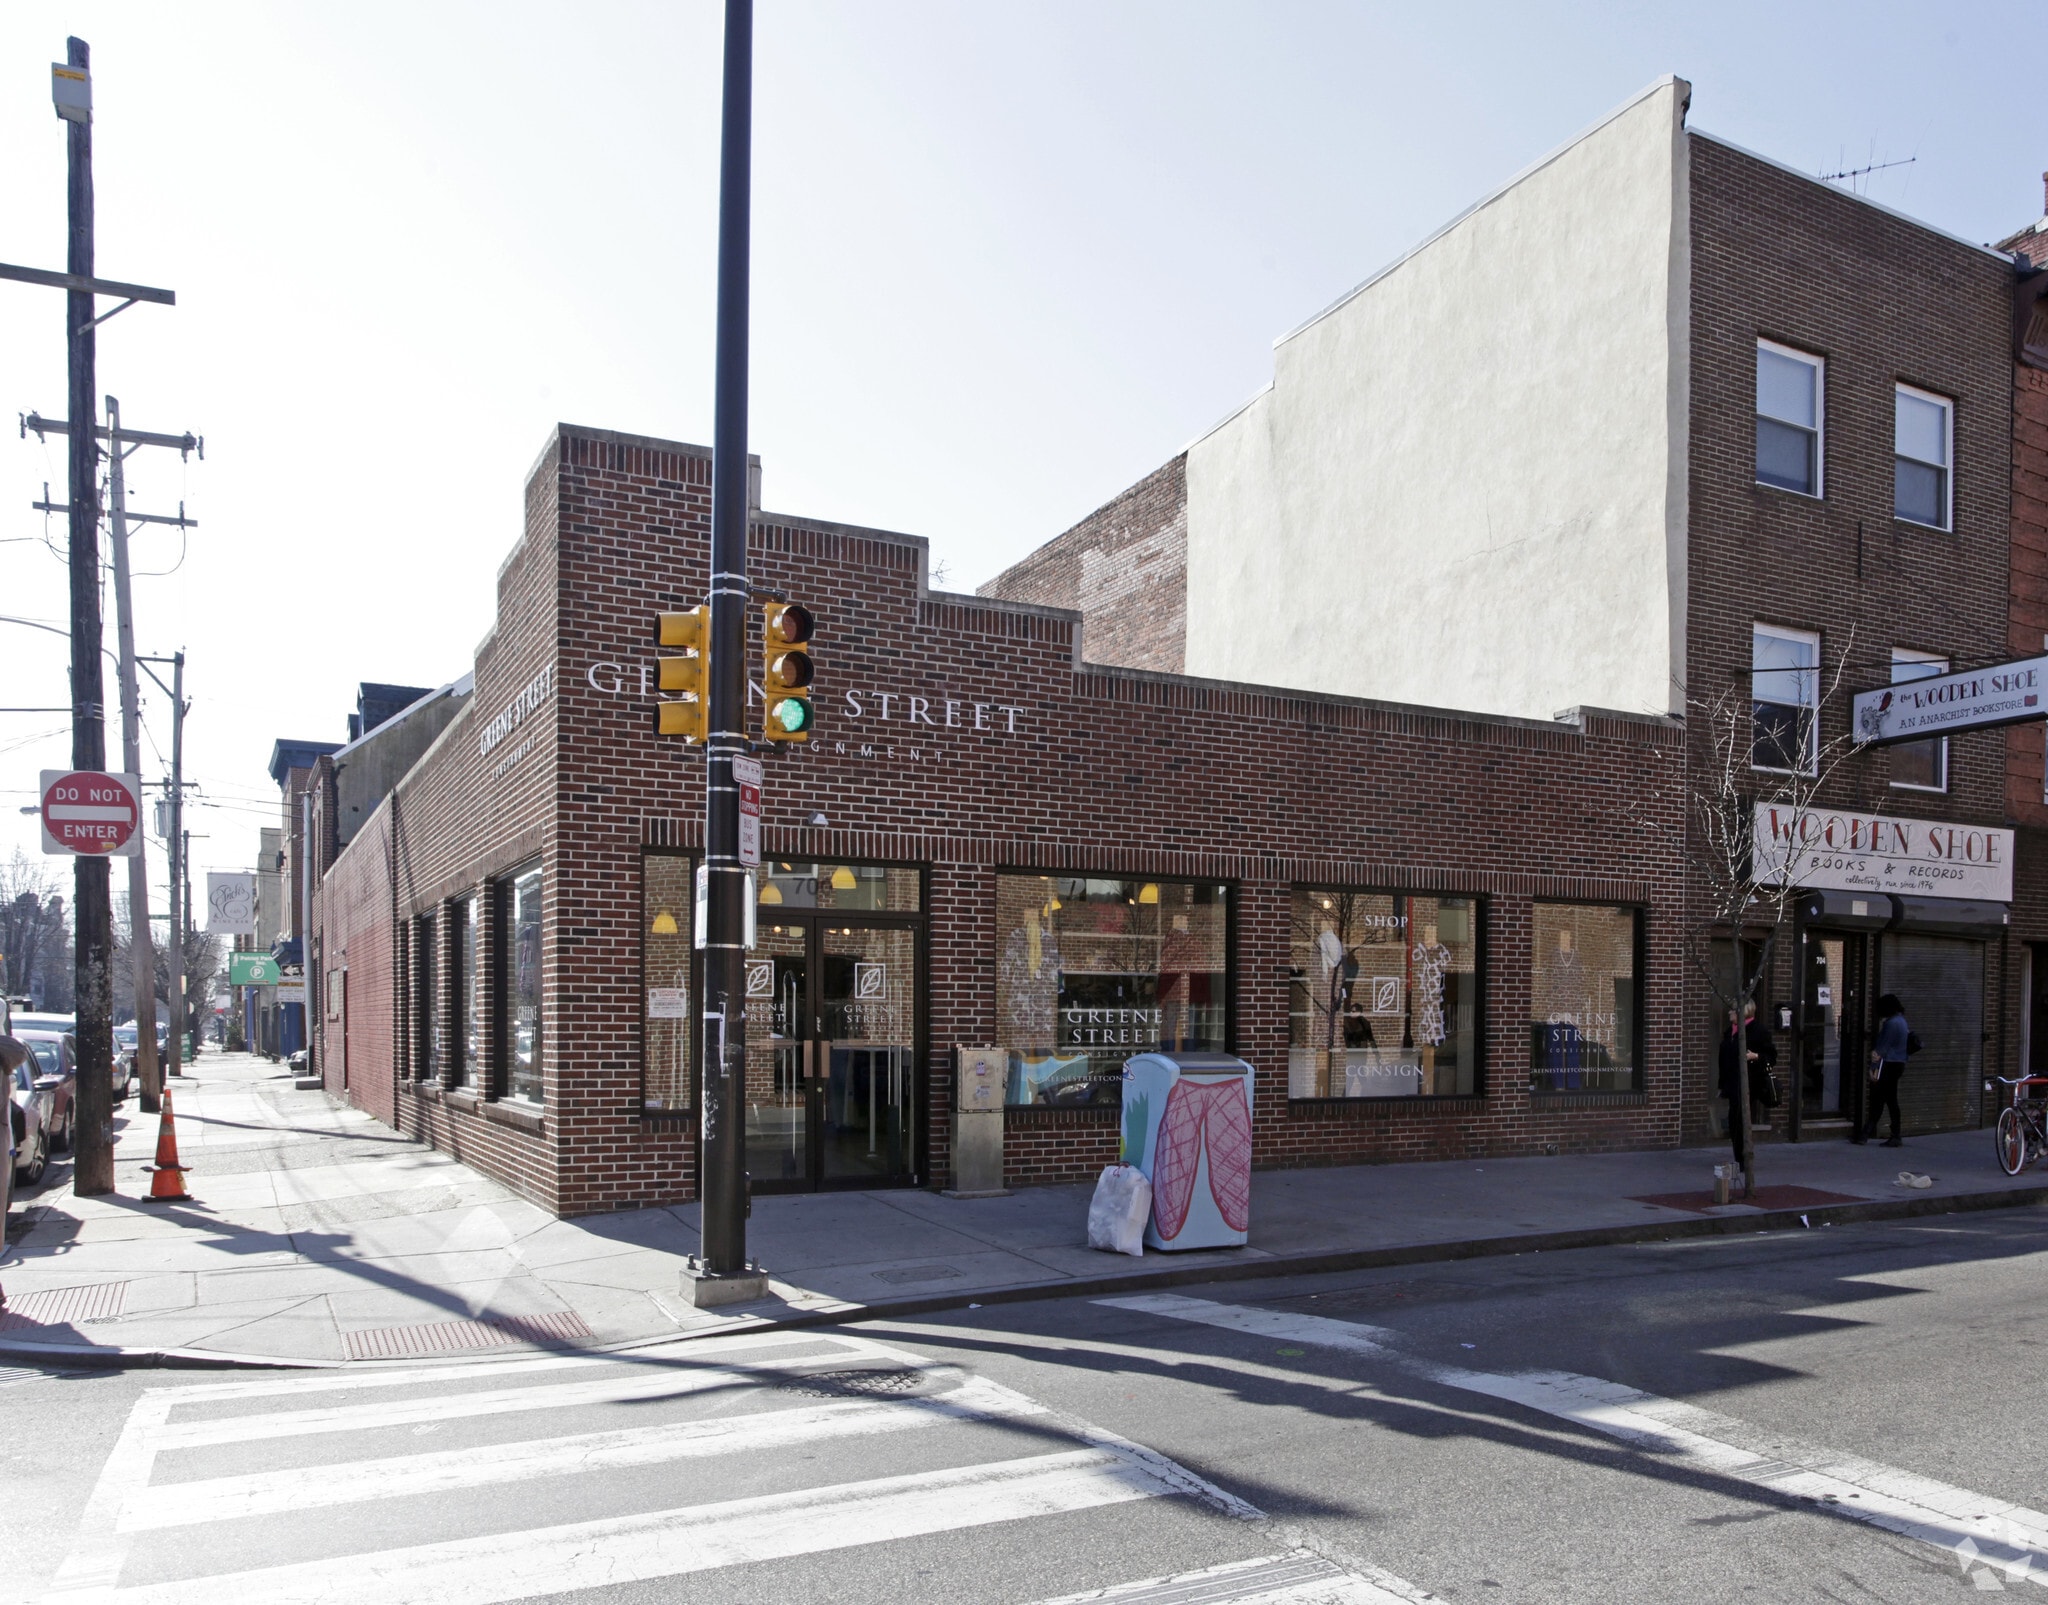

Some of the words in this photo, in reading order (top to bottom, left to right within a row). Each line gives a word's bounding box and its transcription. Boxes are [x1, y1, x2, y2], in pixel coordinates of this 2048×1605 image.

[1900, 693, 1912, 704] the
[1913, 678, 1985, 709] WOODEN
[1991, 667, 2039, 694] SHOE
[480, 703, 513, 757] GREENE
[515, 663, 554, 724] STREET
[844, 690, 1024, 733] STREET
[1899, 719, 1917, 729] AN
[1919, 708, 1971, 727] ANARCHIST
[1972, 698, 2024, 716] BOOKSTORE
[56, 787, 79, 801] DO
[90, 788, 122, 802] NOT
[745, 789, 752, 800] NO
[741, 799, 759, 815] STOPPING
[64, 824, 118, 839] ENTER
[743, 818, 753, 830] BUS
[743, 831, 754, 845] ZONE
[1769, 808, 1910, 855] WOODEN
[1927, 826, 2002, 864] SHOE
[1810, 856, 1866, 872] BOOKS
[1884, 862, 1897, 875] &
[1909, 865, 1965, 880] RECORDS
[1845, 876, 1882, 891] collectively
[1885, 879, 1899, 888] run
[1900, 881, 1916, 889] since
[1917, 880, 1934, 890] 1976
[1365, 914, 1409, 928] SHOP
[517, 1005, 538, 1021] GREENE
[843, 1004, 896, 1014] GREENE
[1067, 1008, 1163, 1024] GREENE
[846, 1014, 894, 1024] STREET
[1549, 1012, 1616, 1025] GREENE
[1072, 1028, 1160, 1044] STREET
[1552, 1029, 1614, 1042] STREET
[1346, 1064, 1425, 1078] CONSIGN
